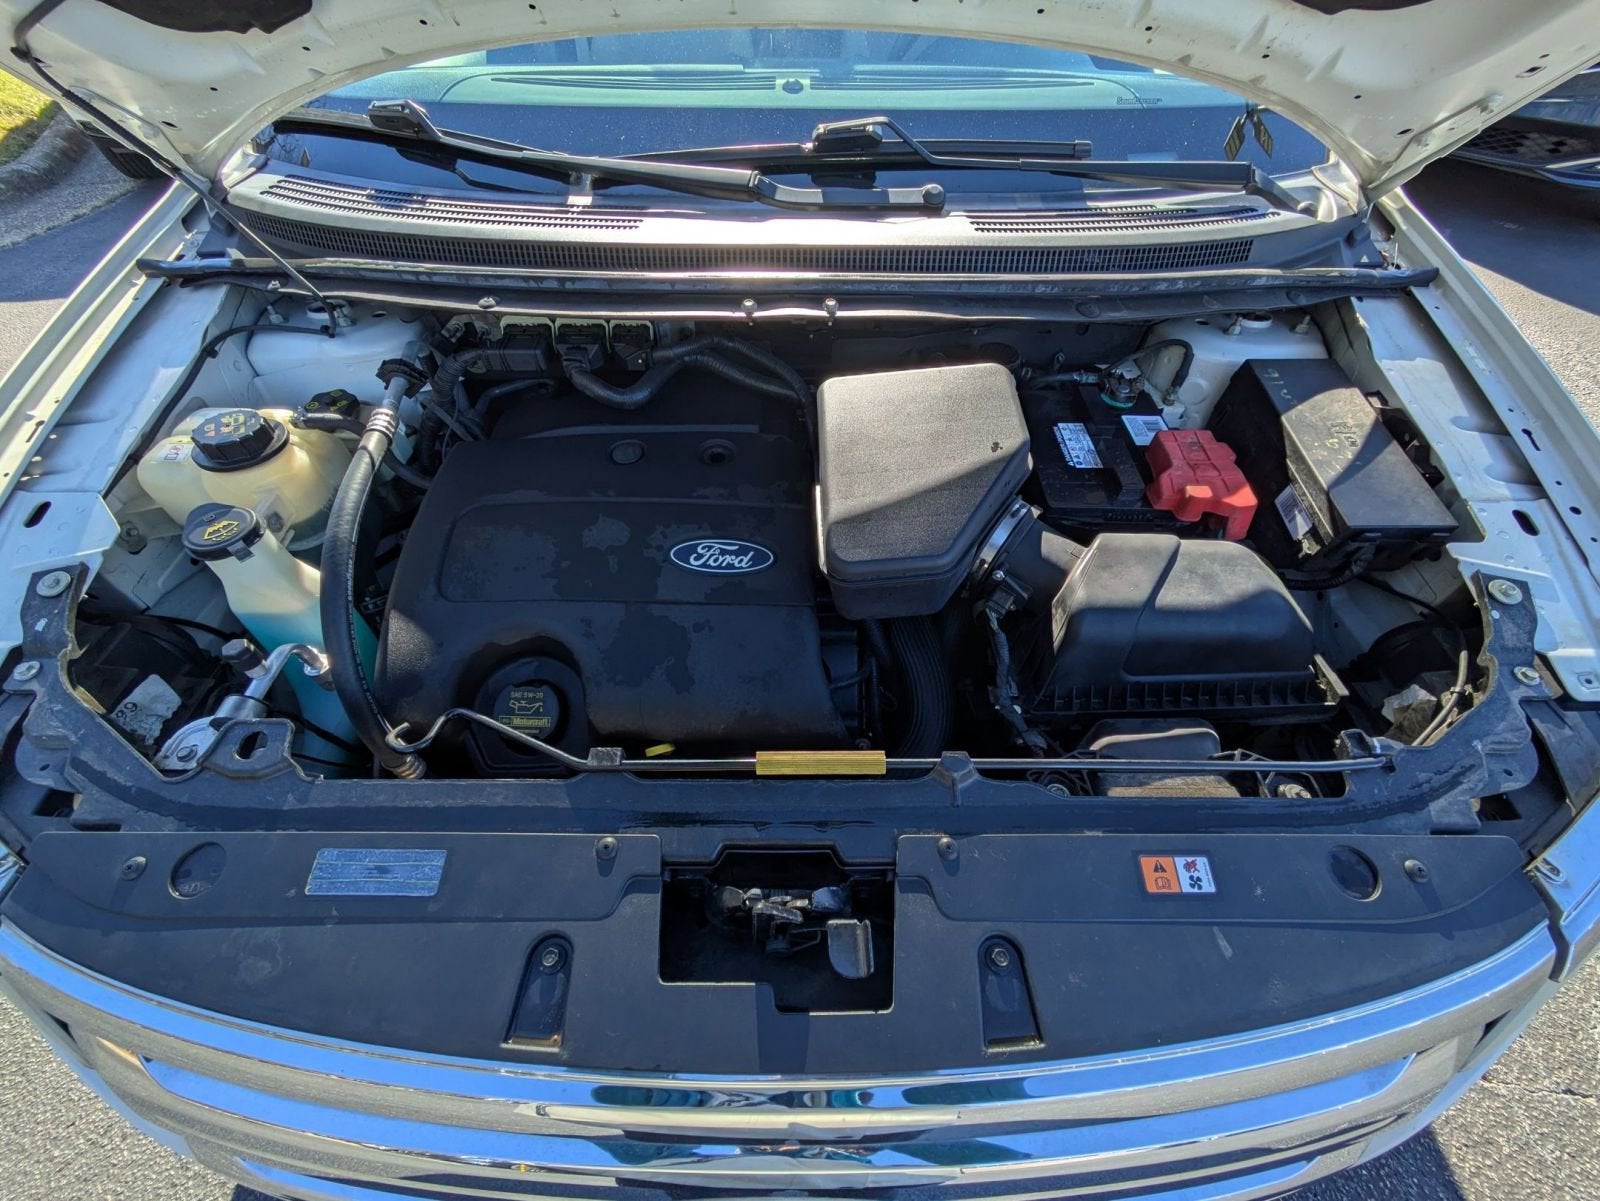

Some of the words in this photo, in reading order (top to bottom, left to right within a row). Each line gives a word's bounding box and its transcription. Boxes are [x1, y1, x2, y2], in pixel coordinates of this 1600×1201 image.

[690, 543, 754, 568] Ford
[523, 691, 544, 699] 5W-20
[512, 717, 549, 726] Motorcraft
